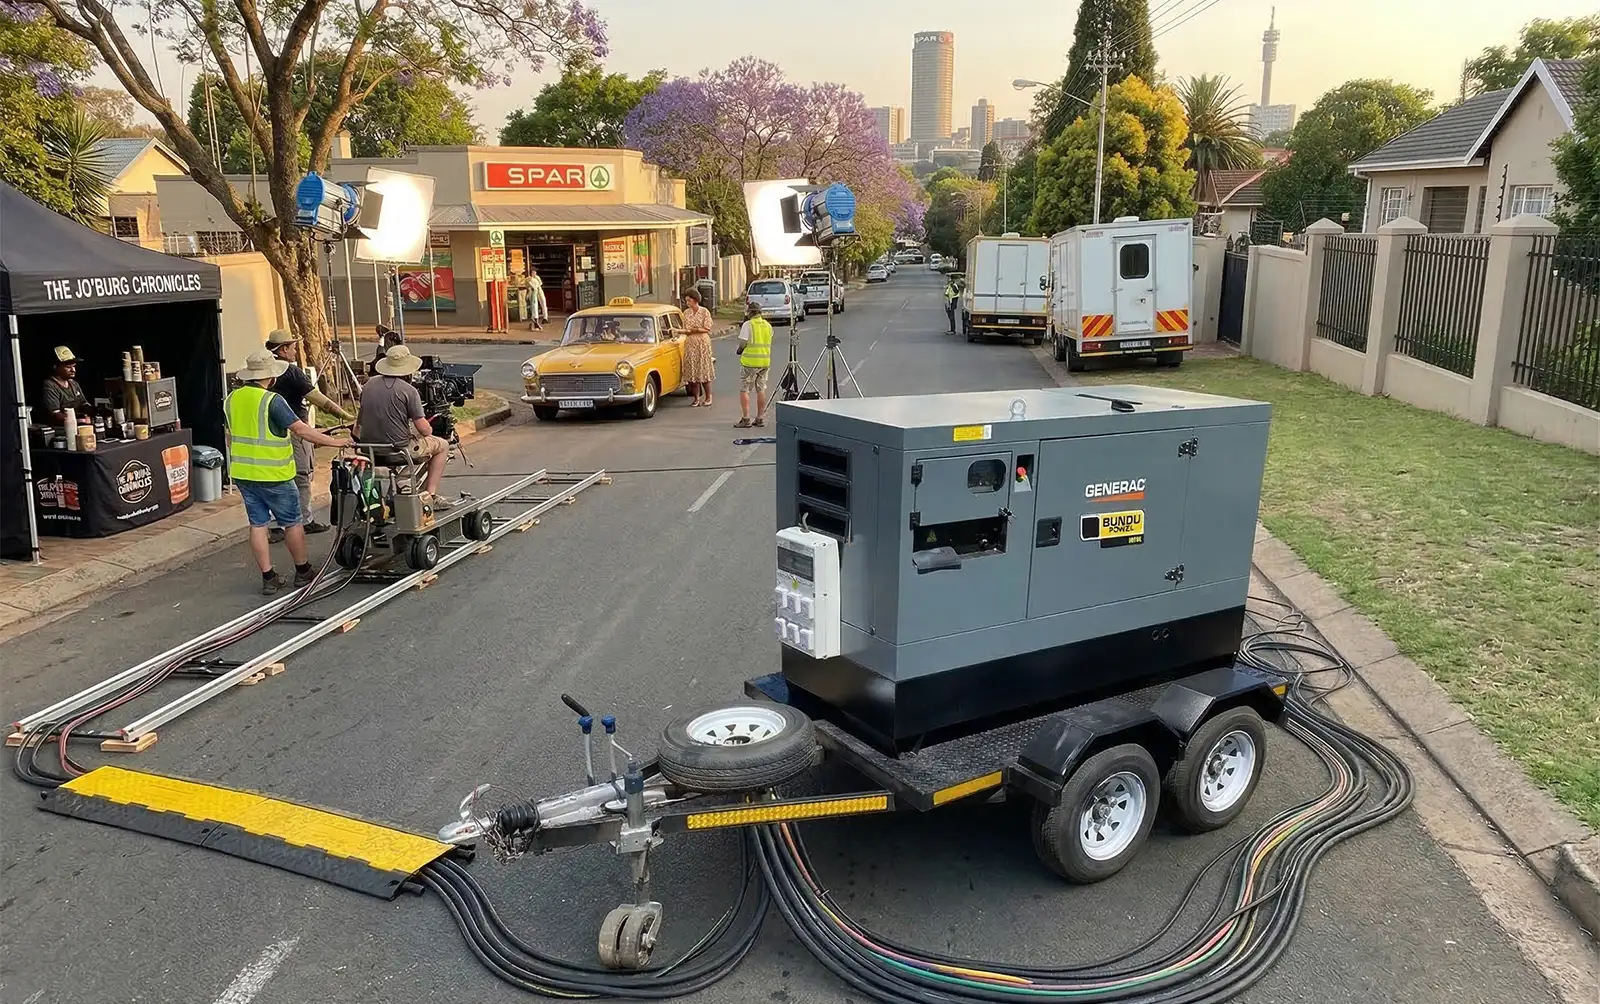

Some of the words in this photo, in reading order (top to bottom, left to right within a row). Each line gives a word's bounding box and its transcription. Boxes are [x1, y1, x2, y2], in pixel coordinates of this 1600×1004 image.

[508, 167, 584, 185] SPAR
[43, 279, 73, 301] THE
[75, 276, 130, 299] JO'BURG
[132, 273, 201, 294] CHRONICLES
[1085, 478, 1146, 498] GENERAC
[1103, 514, 1141, 527] BUNDU
